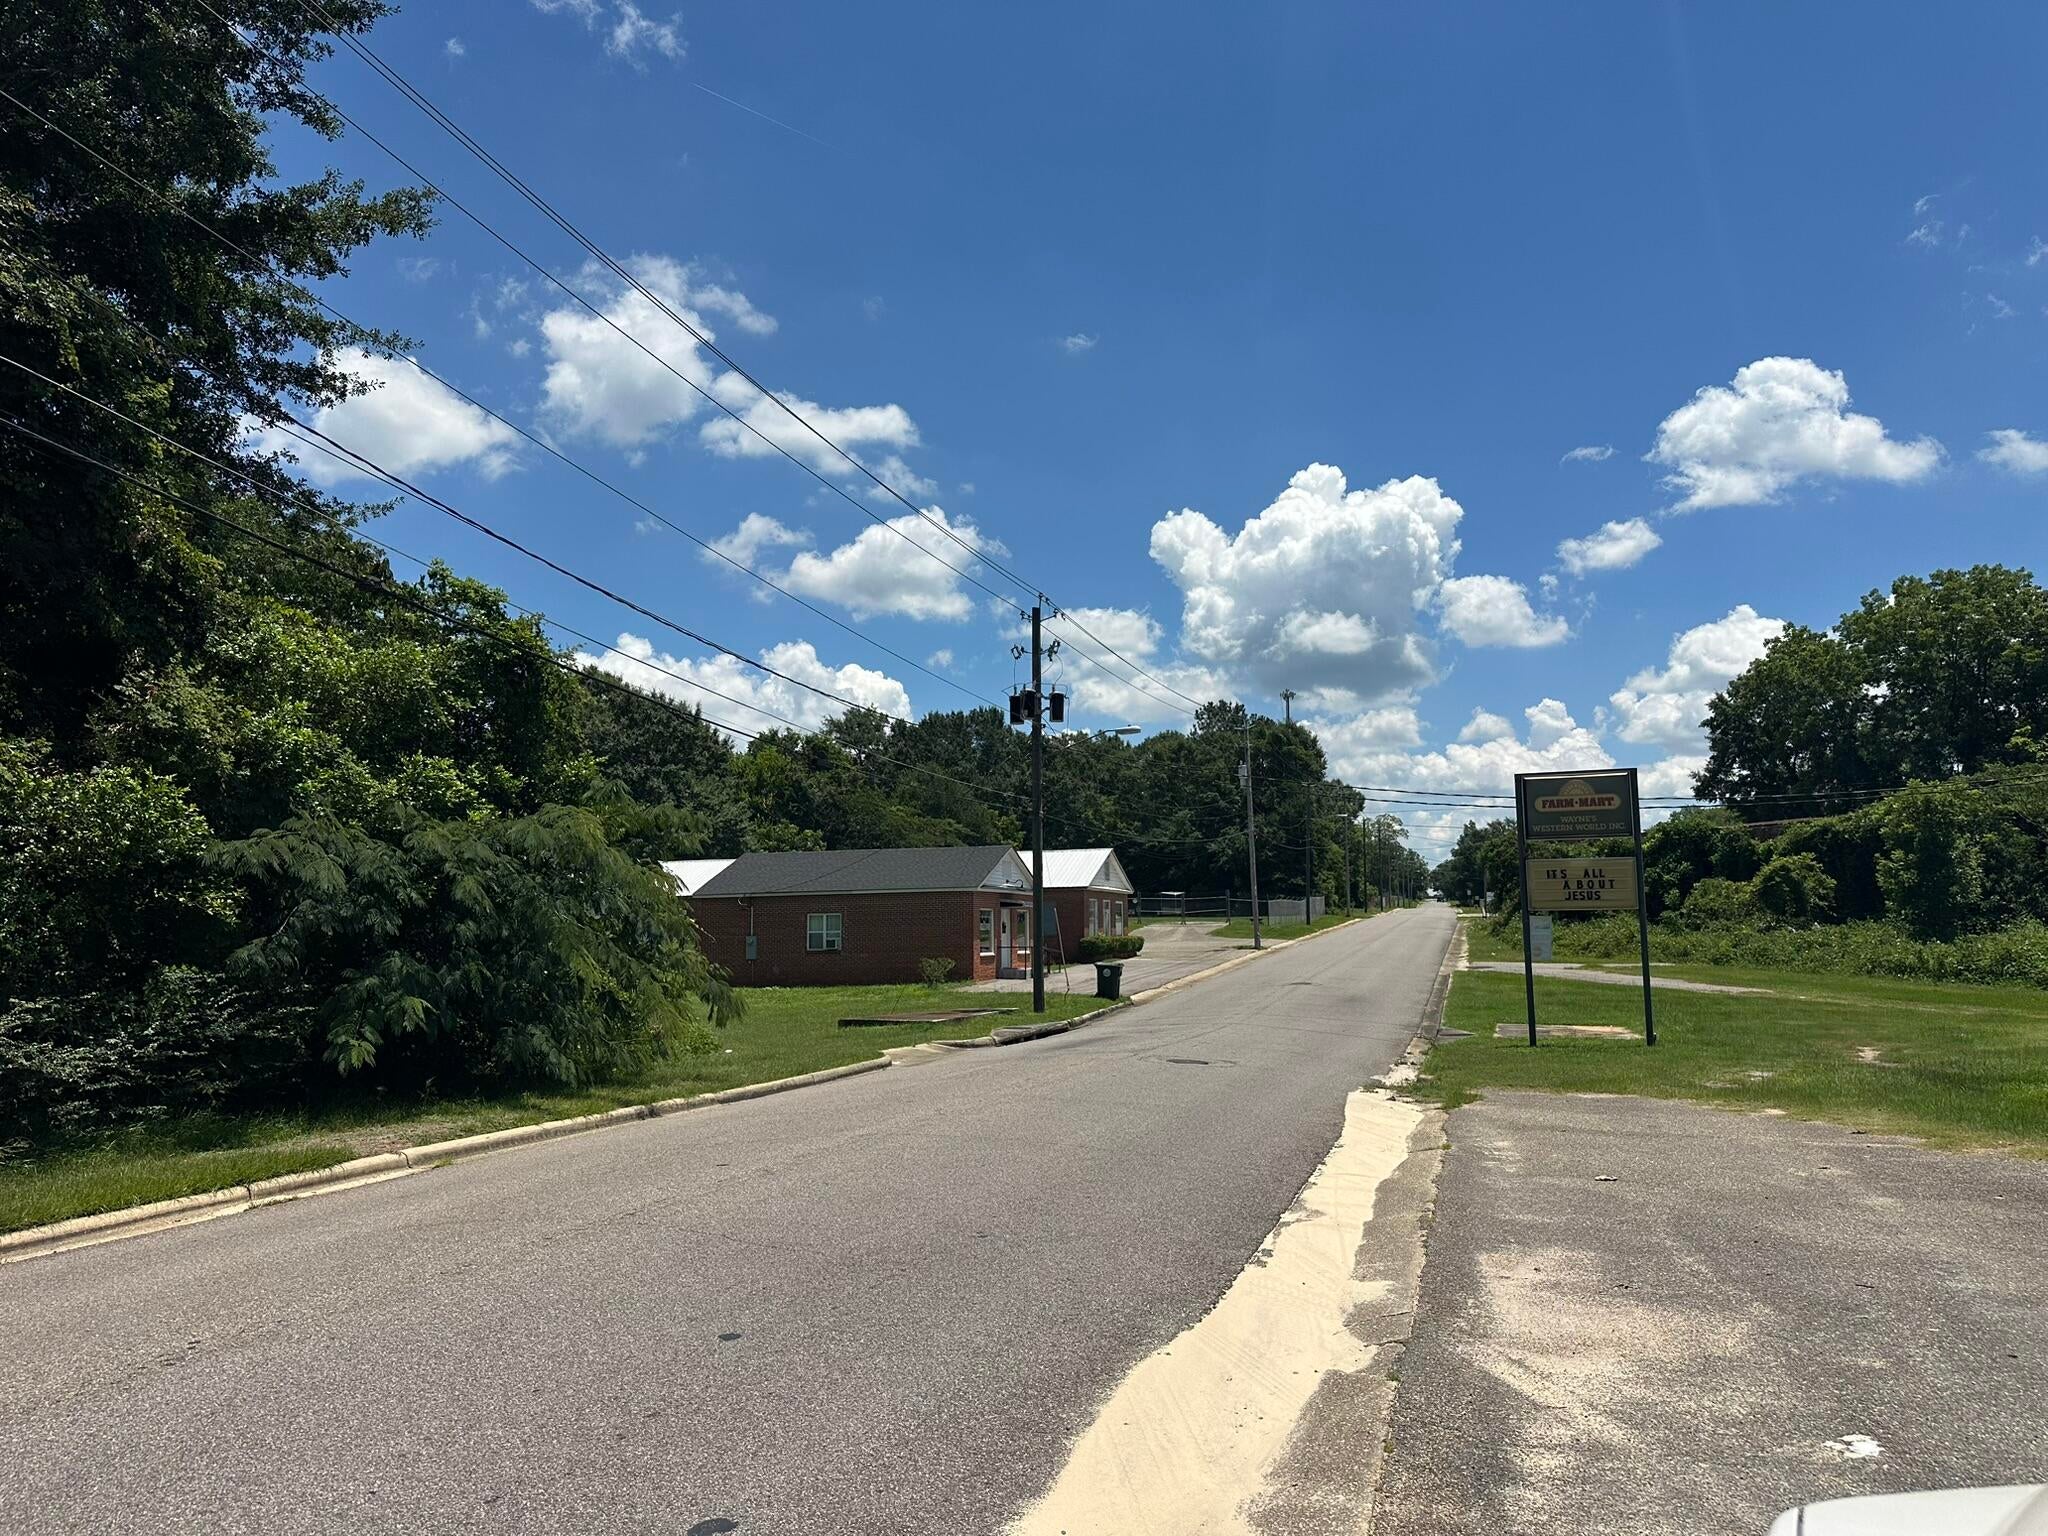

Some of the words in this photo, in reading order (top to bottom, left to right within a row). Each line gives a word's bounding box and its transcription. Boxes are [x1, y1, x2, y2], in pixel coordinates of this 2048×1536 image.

[1560, 815, 1597, 823] WAYNE'S
[1532, 824, 1573, 832] WESTERN
[1575, 823, 1607, 831] WORLD
[1546, 869, 1567, 879] ITS
[1583, 868, 1605, 878] ALL
[1565, 890, 1601, 901] JESUS
